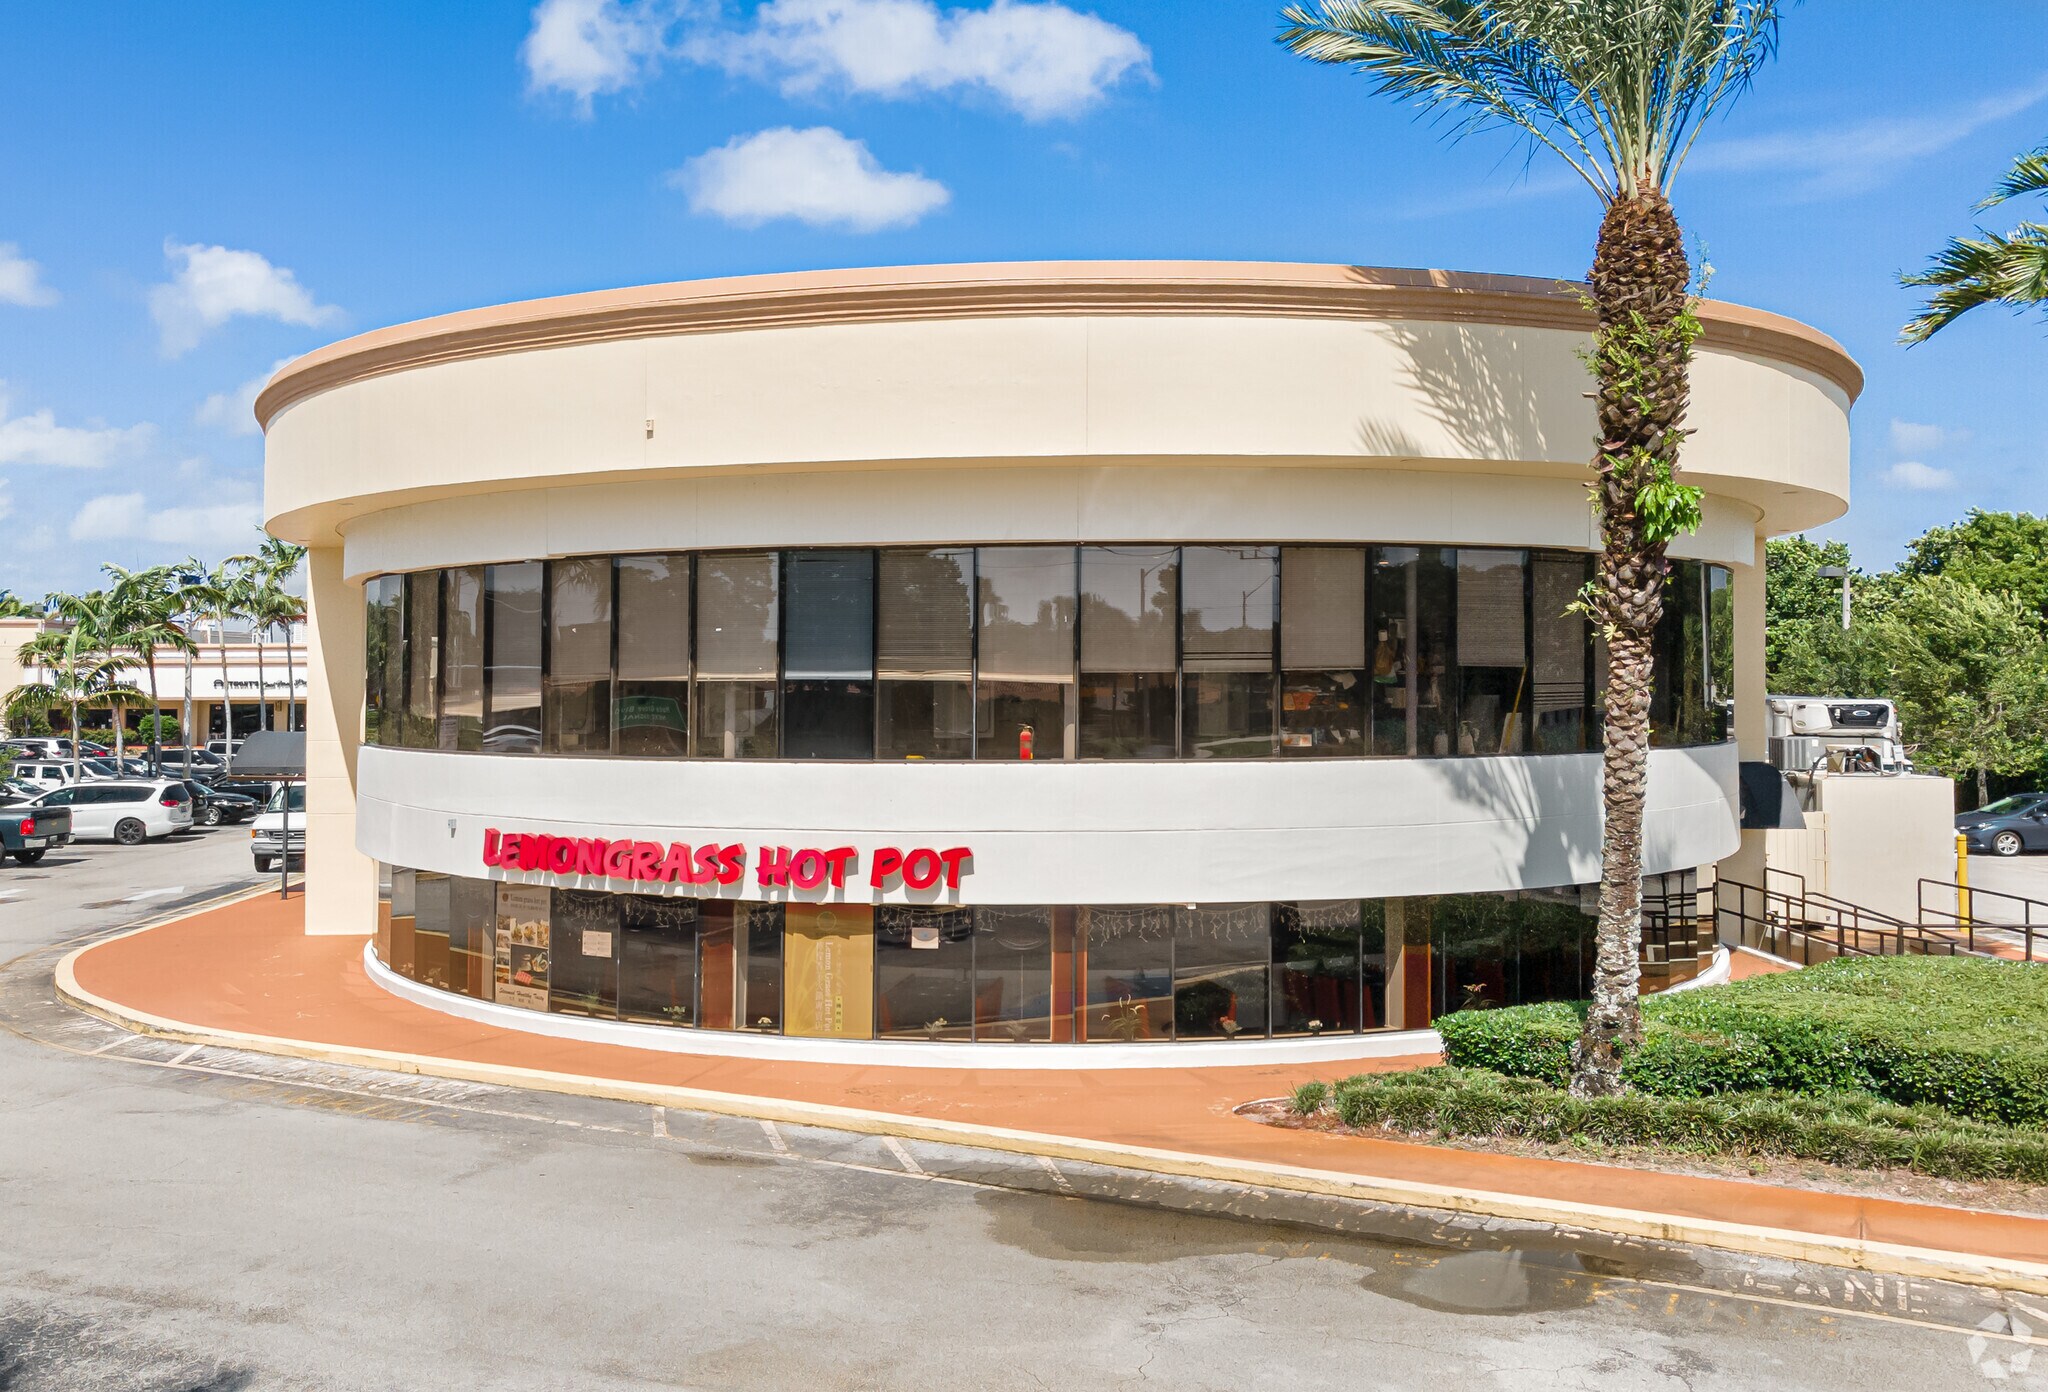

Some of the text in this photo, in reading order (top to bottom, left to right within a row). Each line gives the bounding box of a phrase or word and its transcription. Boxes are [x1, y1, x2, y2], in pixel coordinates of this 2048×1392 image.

[485, 828, 973, 890] LEMONGRASS HOT POT
[824, 941, 833, 971] Lemon
[824, 999, 832, 1015] Hot
[824, 1017, 832, 1032] Pot
[1743, 1258, 1931, 1316] LANE
